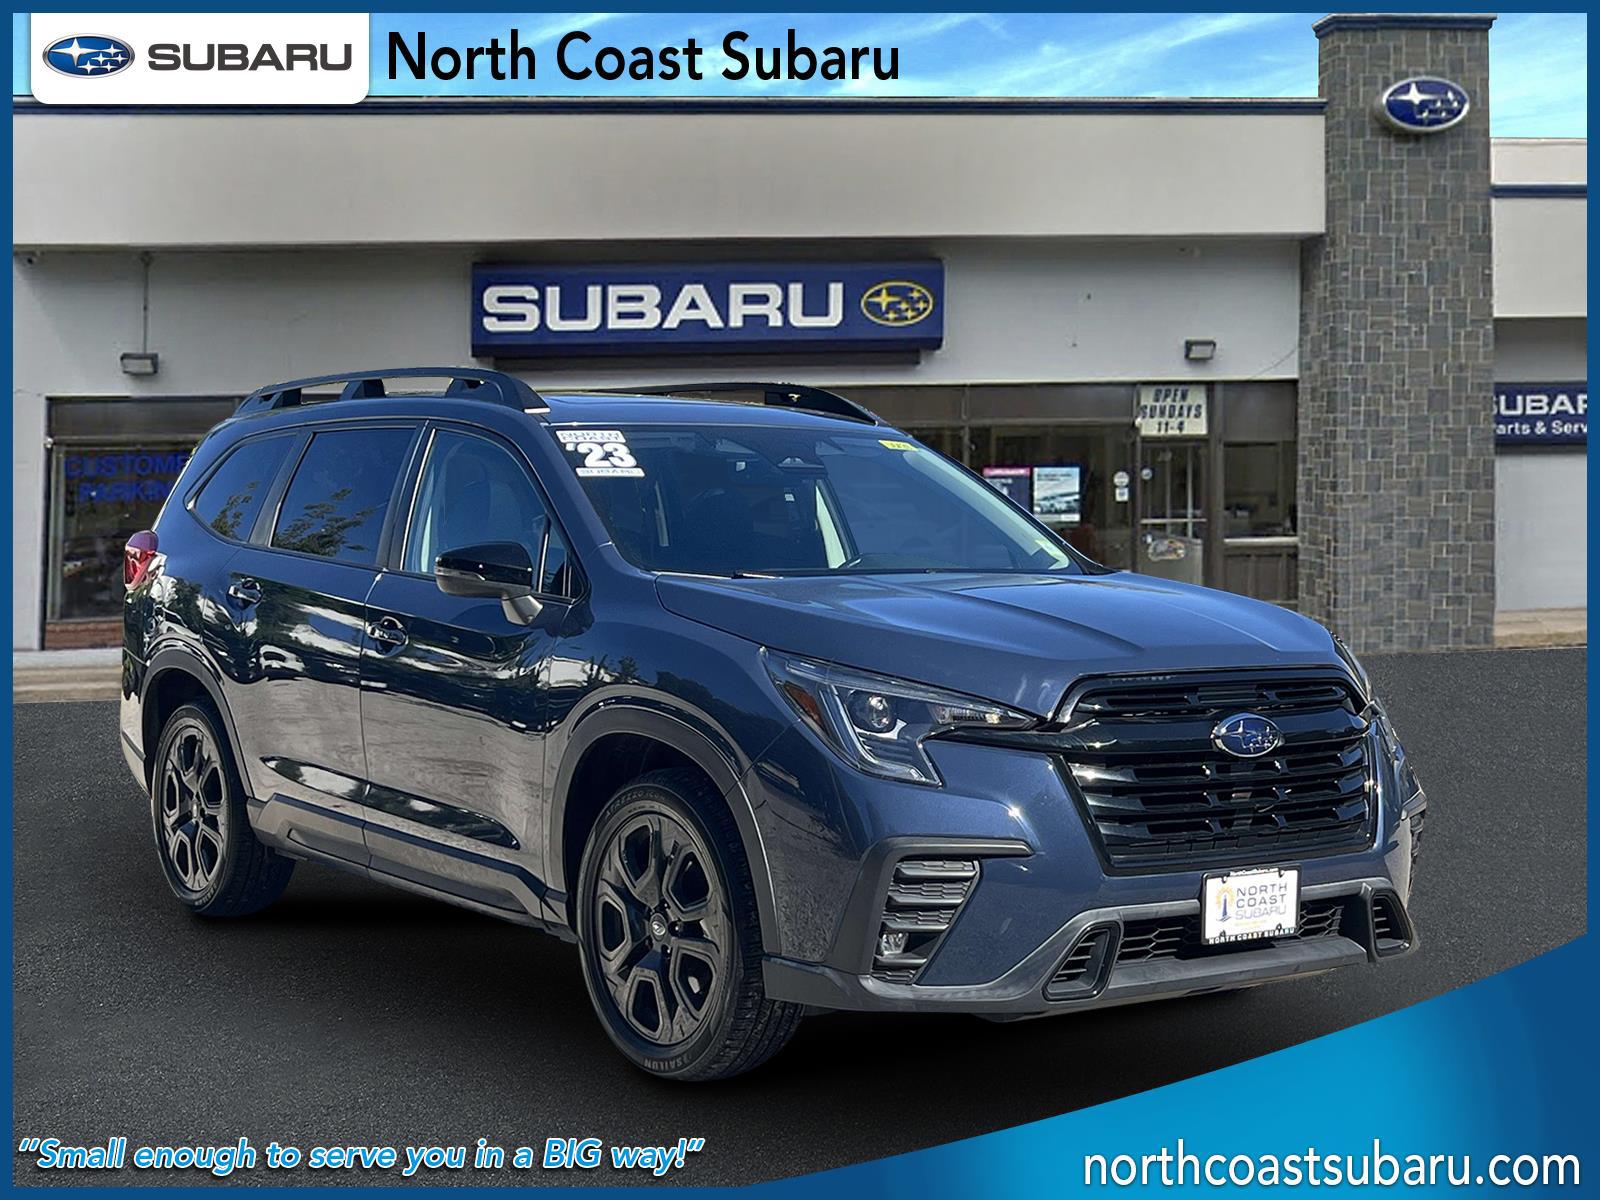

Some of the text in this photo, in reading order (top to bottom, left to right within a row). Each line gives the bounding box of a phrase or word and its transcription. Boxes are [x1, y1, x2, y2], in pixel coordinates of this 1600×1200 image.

[482, 282, 843, 332] SUBARU
[1153, 388, 1189, 403] OPEN
[1140, 404, 1202, 419] SUNDAYS
[1493, 394, 1587, 415] UBA
[1157, 421, 1185, 433] 11-4
[1535, 421, 1547, 435] &
[1236, 882, 1288, 897] NORTH
[1236, 894, 1287, 909] COAST
[1235, 905, 1287, 920] SUBARU
